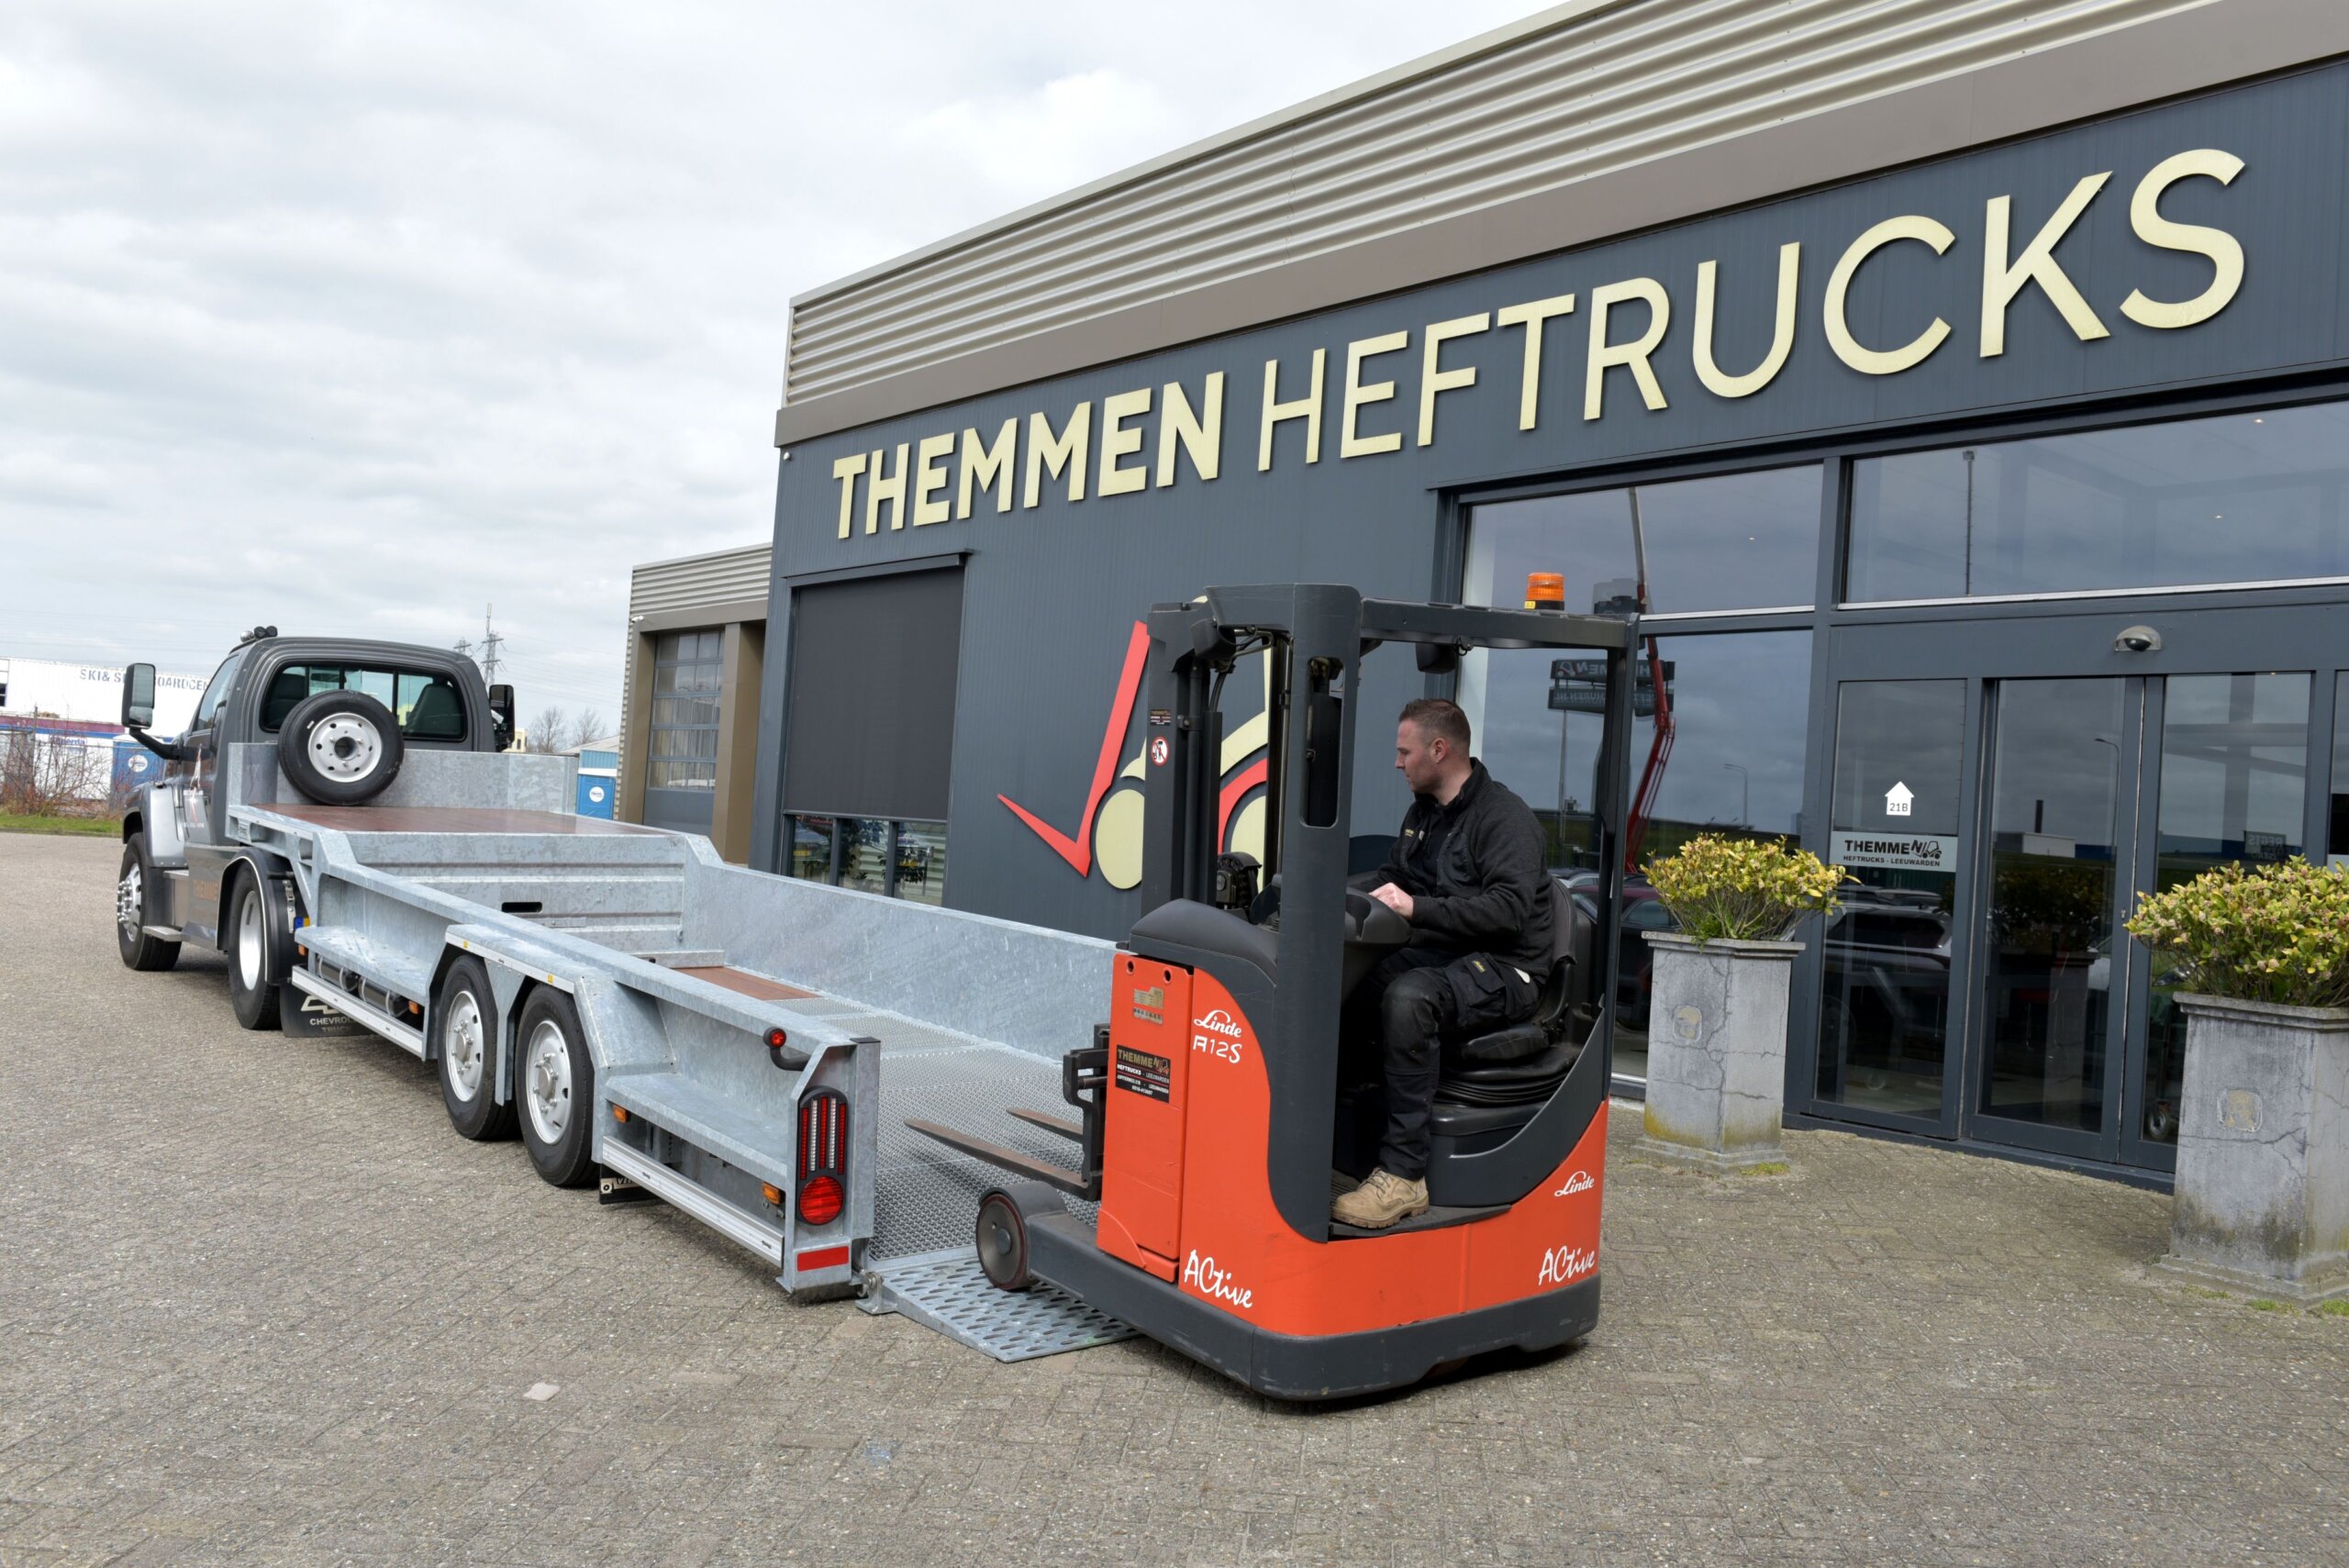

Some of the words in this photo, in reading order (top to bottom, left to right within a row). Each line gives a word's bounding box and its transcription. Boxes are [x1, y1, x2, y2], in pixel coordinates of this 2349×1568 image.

[832, 372, 1224, 539] THEMMEN
[1258, 149, 2246, 472] HEFTRUCKS
[1890, 803, 1909, 812] 21B
[1844, 840, 1922, 854] THEMMEN
[1843, 855, 1885, 863] HEFTRUCKS
[1891, 858, 1940, 867] LEEUWARDEN
[1194, 1009, 1242, 1038] Linde
[1118, 1049, 1160, 1068] THEMMEN
[1117, 1063, 1141, 1075] HEFTRUCKS
[1554, 1171, 1595, 1196] Linde
